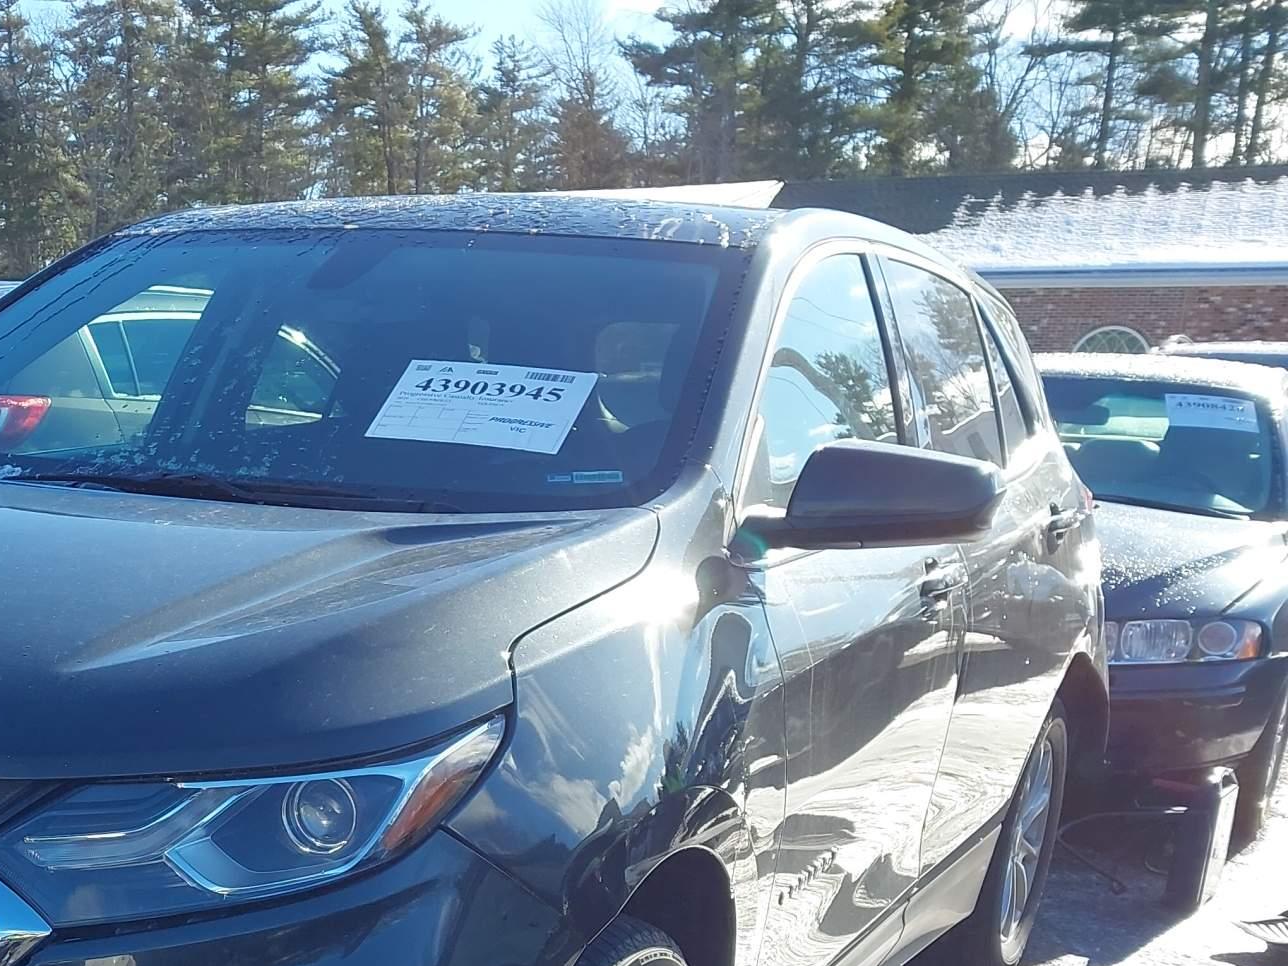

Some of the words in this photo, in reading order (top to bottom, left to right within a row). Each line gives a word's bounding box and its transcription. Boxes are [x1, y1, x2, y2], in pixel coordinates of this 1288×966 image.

[415, 378, 565, 402] 43903945
[489, 416, 556, 429] PROGRESSIVE
[510, 426, 527, 434] VIC
